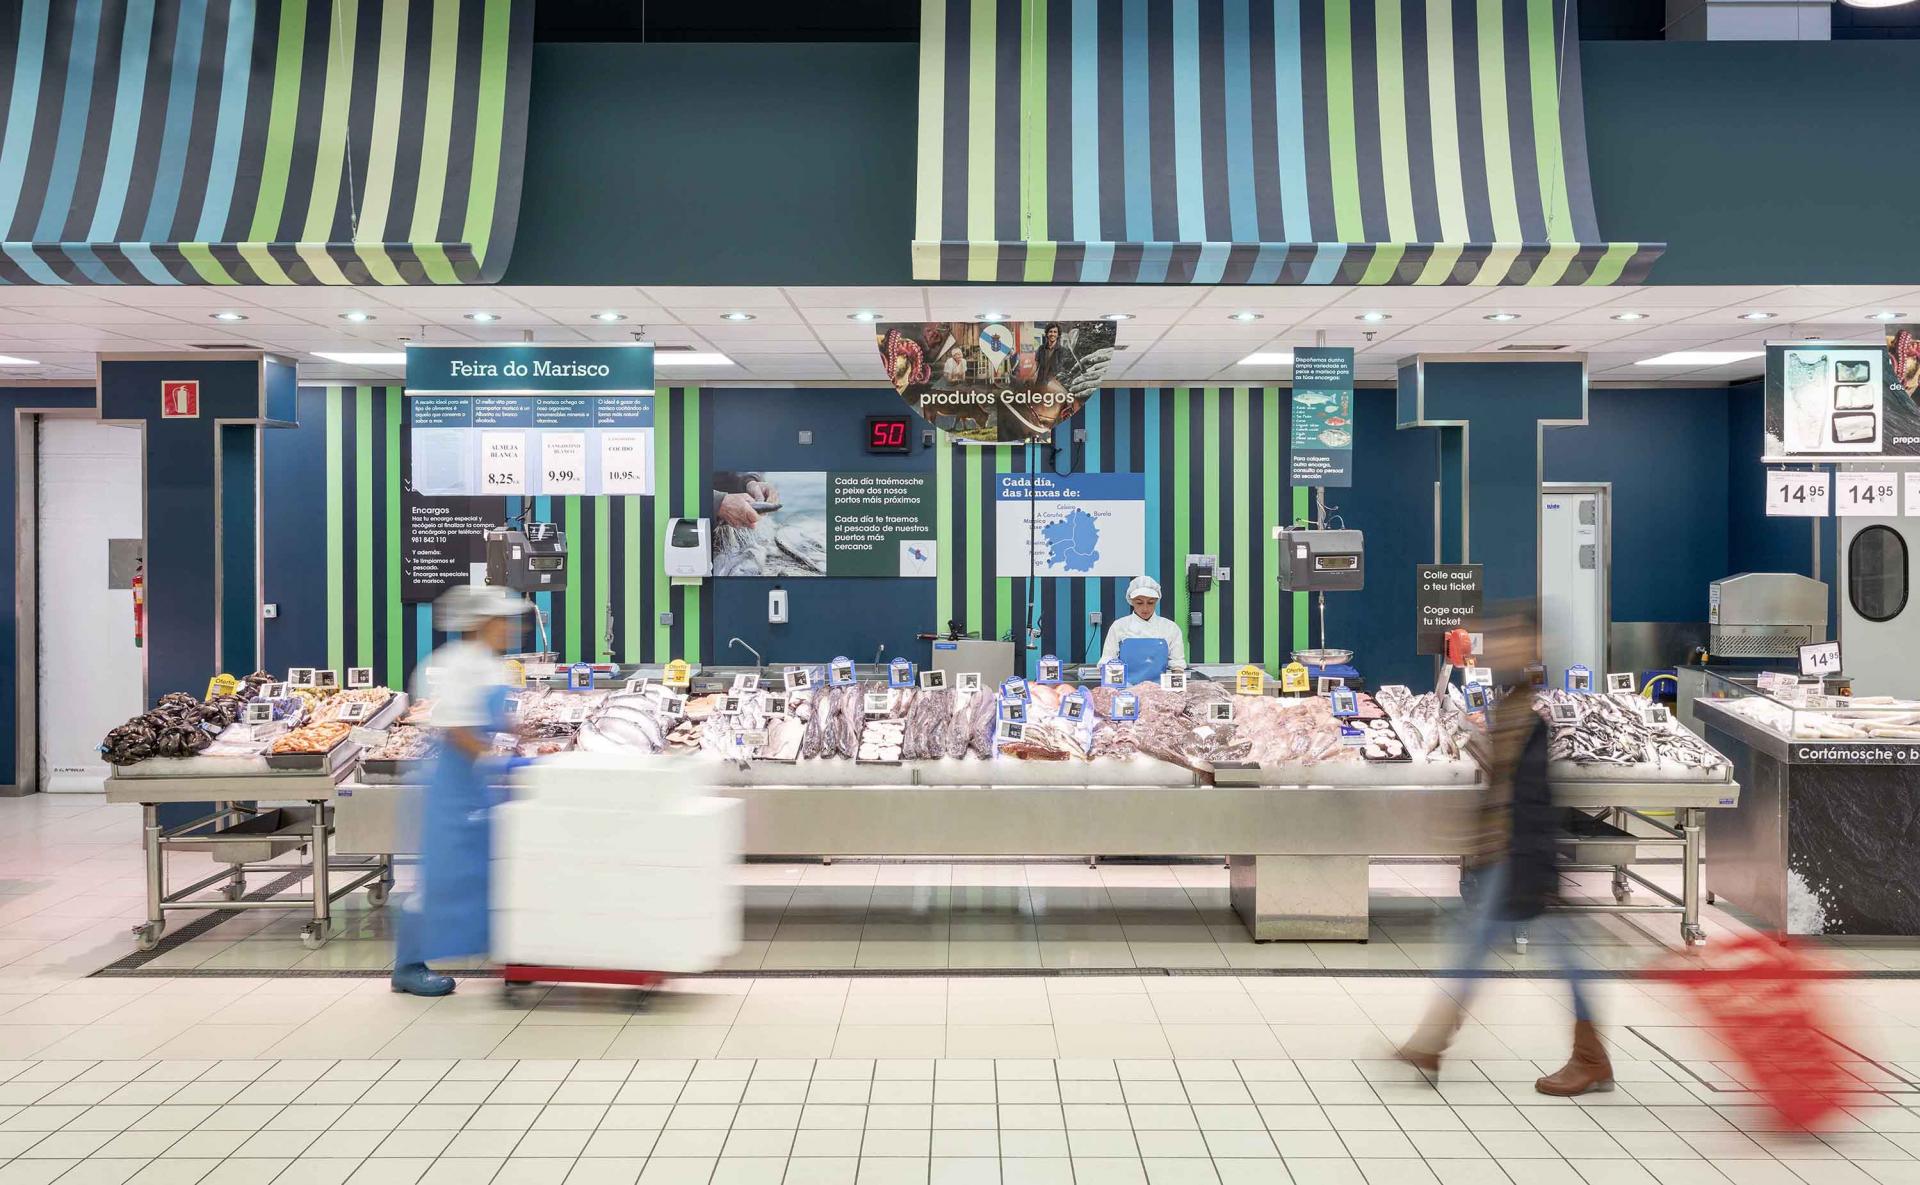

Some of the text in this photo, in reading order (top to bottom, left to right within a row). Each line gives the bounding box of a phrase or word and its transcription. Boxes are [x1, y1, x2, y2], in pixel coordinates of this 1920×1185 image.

[450, 361, 609, 377] Feira do Marisco
[920, 390, 1074, 407] produtos Galegos
[873, 423, 904, 445] 50
[488, 473, 513, 485] 8,25
[1003, 477, 1055, 487] Cada día,
[843, 487, 865, 495] peixe
[1003, 489, 1080, 498] das lonxas de:
[835, 496, 920, 505] portos máis próximos
[412, 507, 449, 515] Encargos
[845, 525, 880, 534] pescado
[1424, 571, 1472, 580] Colle aquí
[1424, 606, 1473, 615] Coge aquí
[1424, 618, 1460, 626] tu ticket
[215, 678, 235, 686] Oferta
[1799, 747, 1892, 760] Cortámosche
[1897, 750, 1906, 760] o
